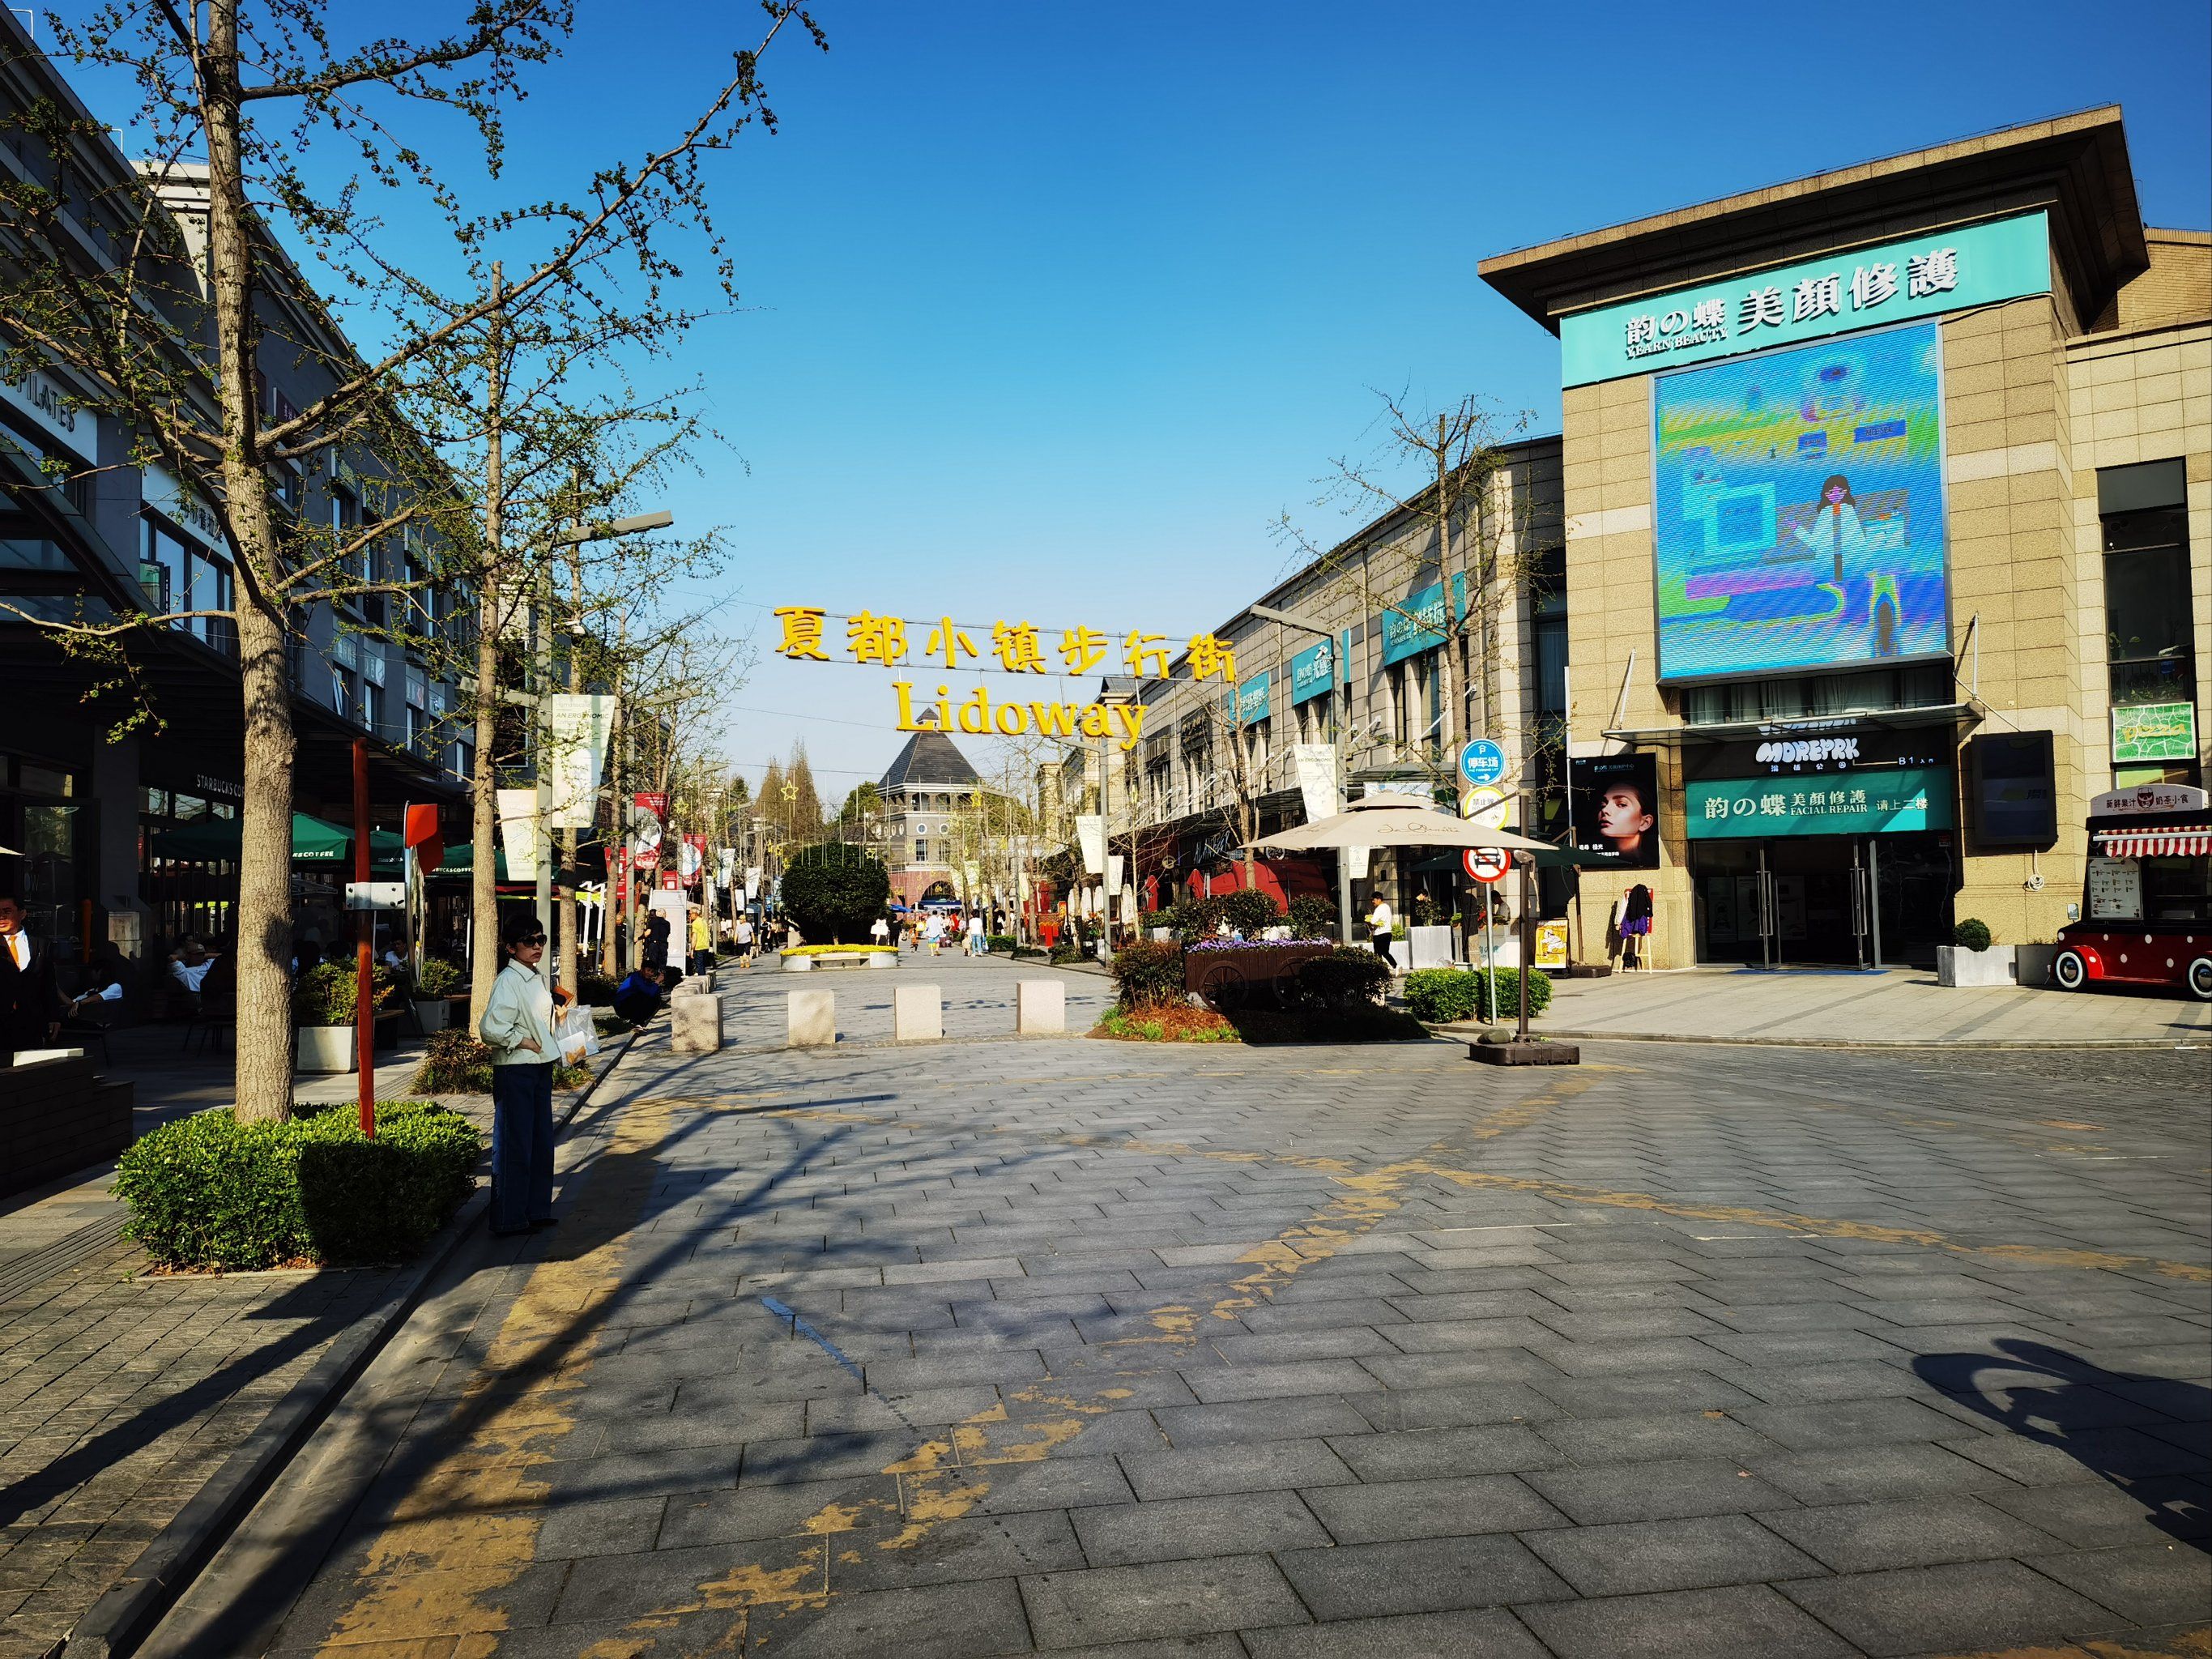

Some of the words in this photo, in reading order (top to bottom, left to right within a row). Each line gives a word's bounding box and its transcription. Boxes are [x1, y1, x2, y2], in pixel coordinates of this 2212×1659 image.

[1626, 337, 1672, 359] YEARN
[1673, 325, 1728, 348] BEAUTY
[774, 606, 1237, 684] 夏都小镇步行街
[892, 681, 1149, 751] Lidoway
[1468, 756, 1498, 768] 停车场
[1755, 737, 1860, 763] MOREPRK
[197, 774, 233, 795] STARBUCKS
[1705, 794, 1786, 819] 韵の蝶
[1790, 806, 1827, 816] FACIAL
[1829, 804, 1868, 814] REPAIR
[1876, 797, 1929, 812] 请上二楼
